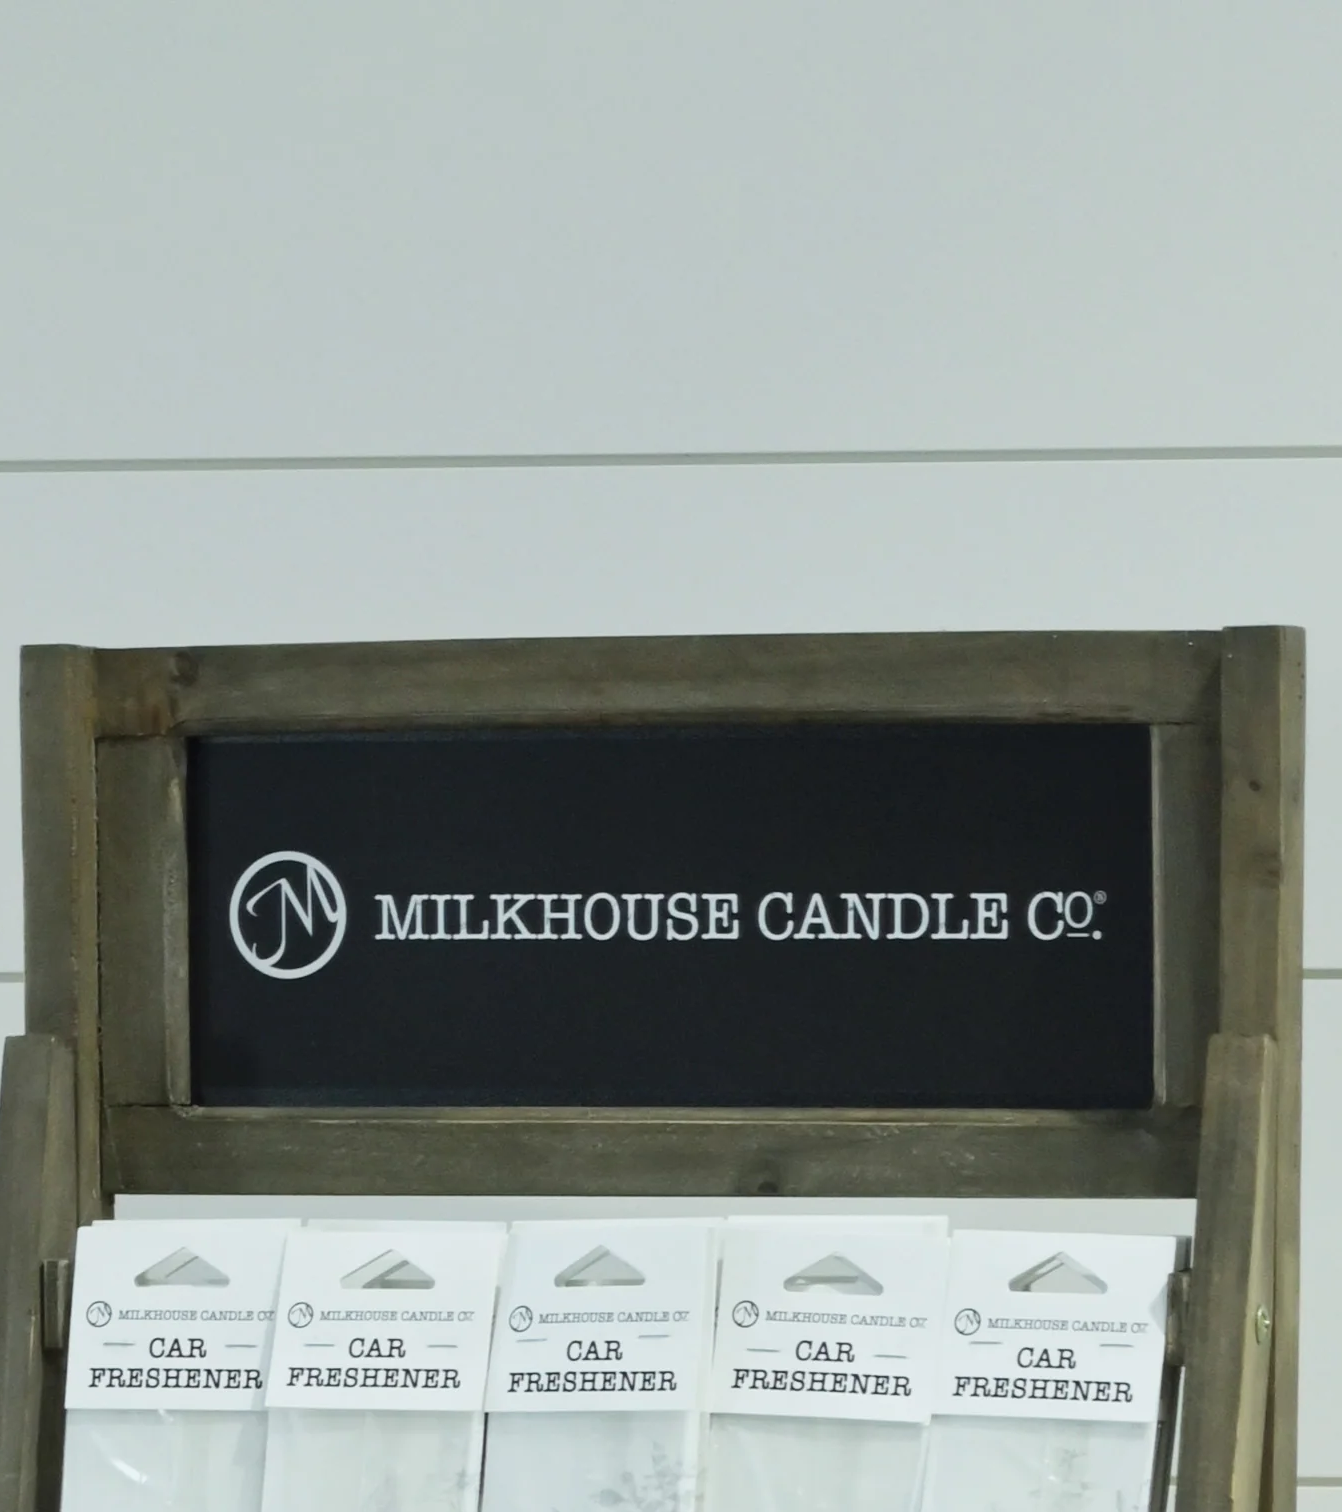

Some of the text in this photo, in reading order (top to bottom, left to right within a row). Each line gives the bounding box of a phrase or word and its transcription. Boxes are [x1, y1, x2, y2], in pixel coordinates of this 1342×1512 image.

[374, 892, 740, 941] MILKHOUSE
[757, 891, 1009, 941] CANDLE
[118, 1309, 197, 1321] MILKHOUSE
[200, 1310, 255, 1322] CANDLE
[319, 1310, 398, 1322] MILKHOUSE
[401, 1310, 455, 1322] CANDLE
[538, 1312, 614, 1324] MILKHOUSE
[617, 1311, 670, 1322] CANDLE
[765, 1310, 847, 1324] MILKHOUSE
[850, 1314, 906, 1328] CANDLE
[987, 1318, 1069, 1331] MILKHOUSE
[1071, 1320, 1127, 1334] CANDLE
[149, 1337, 207, 1358] CAR
[348, 1337, 406, 1358] CAR
[566, 1340, 623, 1361] CAR
[795, 1340, 855, 1363] CAR
[1017, 1346, 1076, 1370] CAR
[88, 1367, 263, 1389] FRESHENER
[286, 1366, 461, 1388] FRESHENER
[507, 1370, 677, 1393] FRESHENER
[731, 1368, 911, 1397] FRESHENER
[952, 1376, 1133, 1403] FRESHENER
